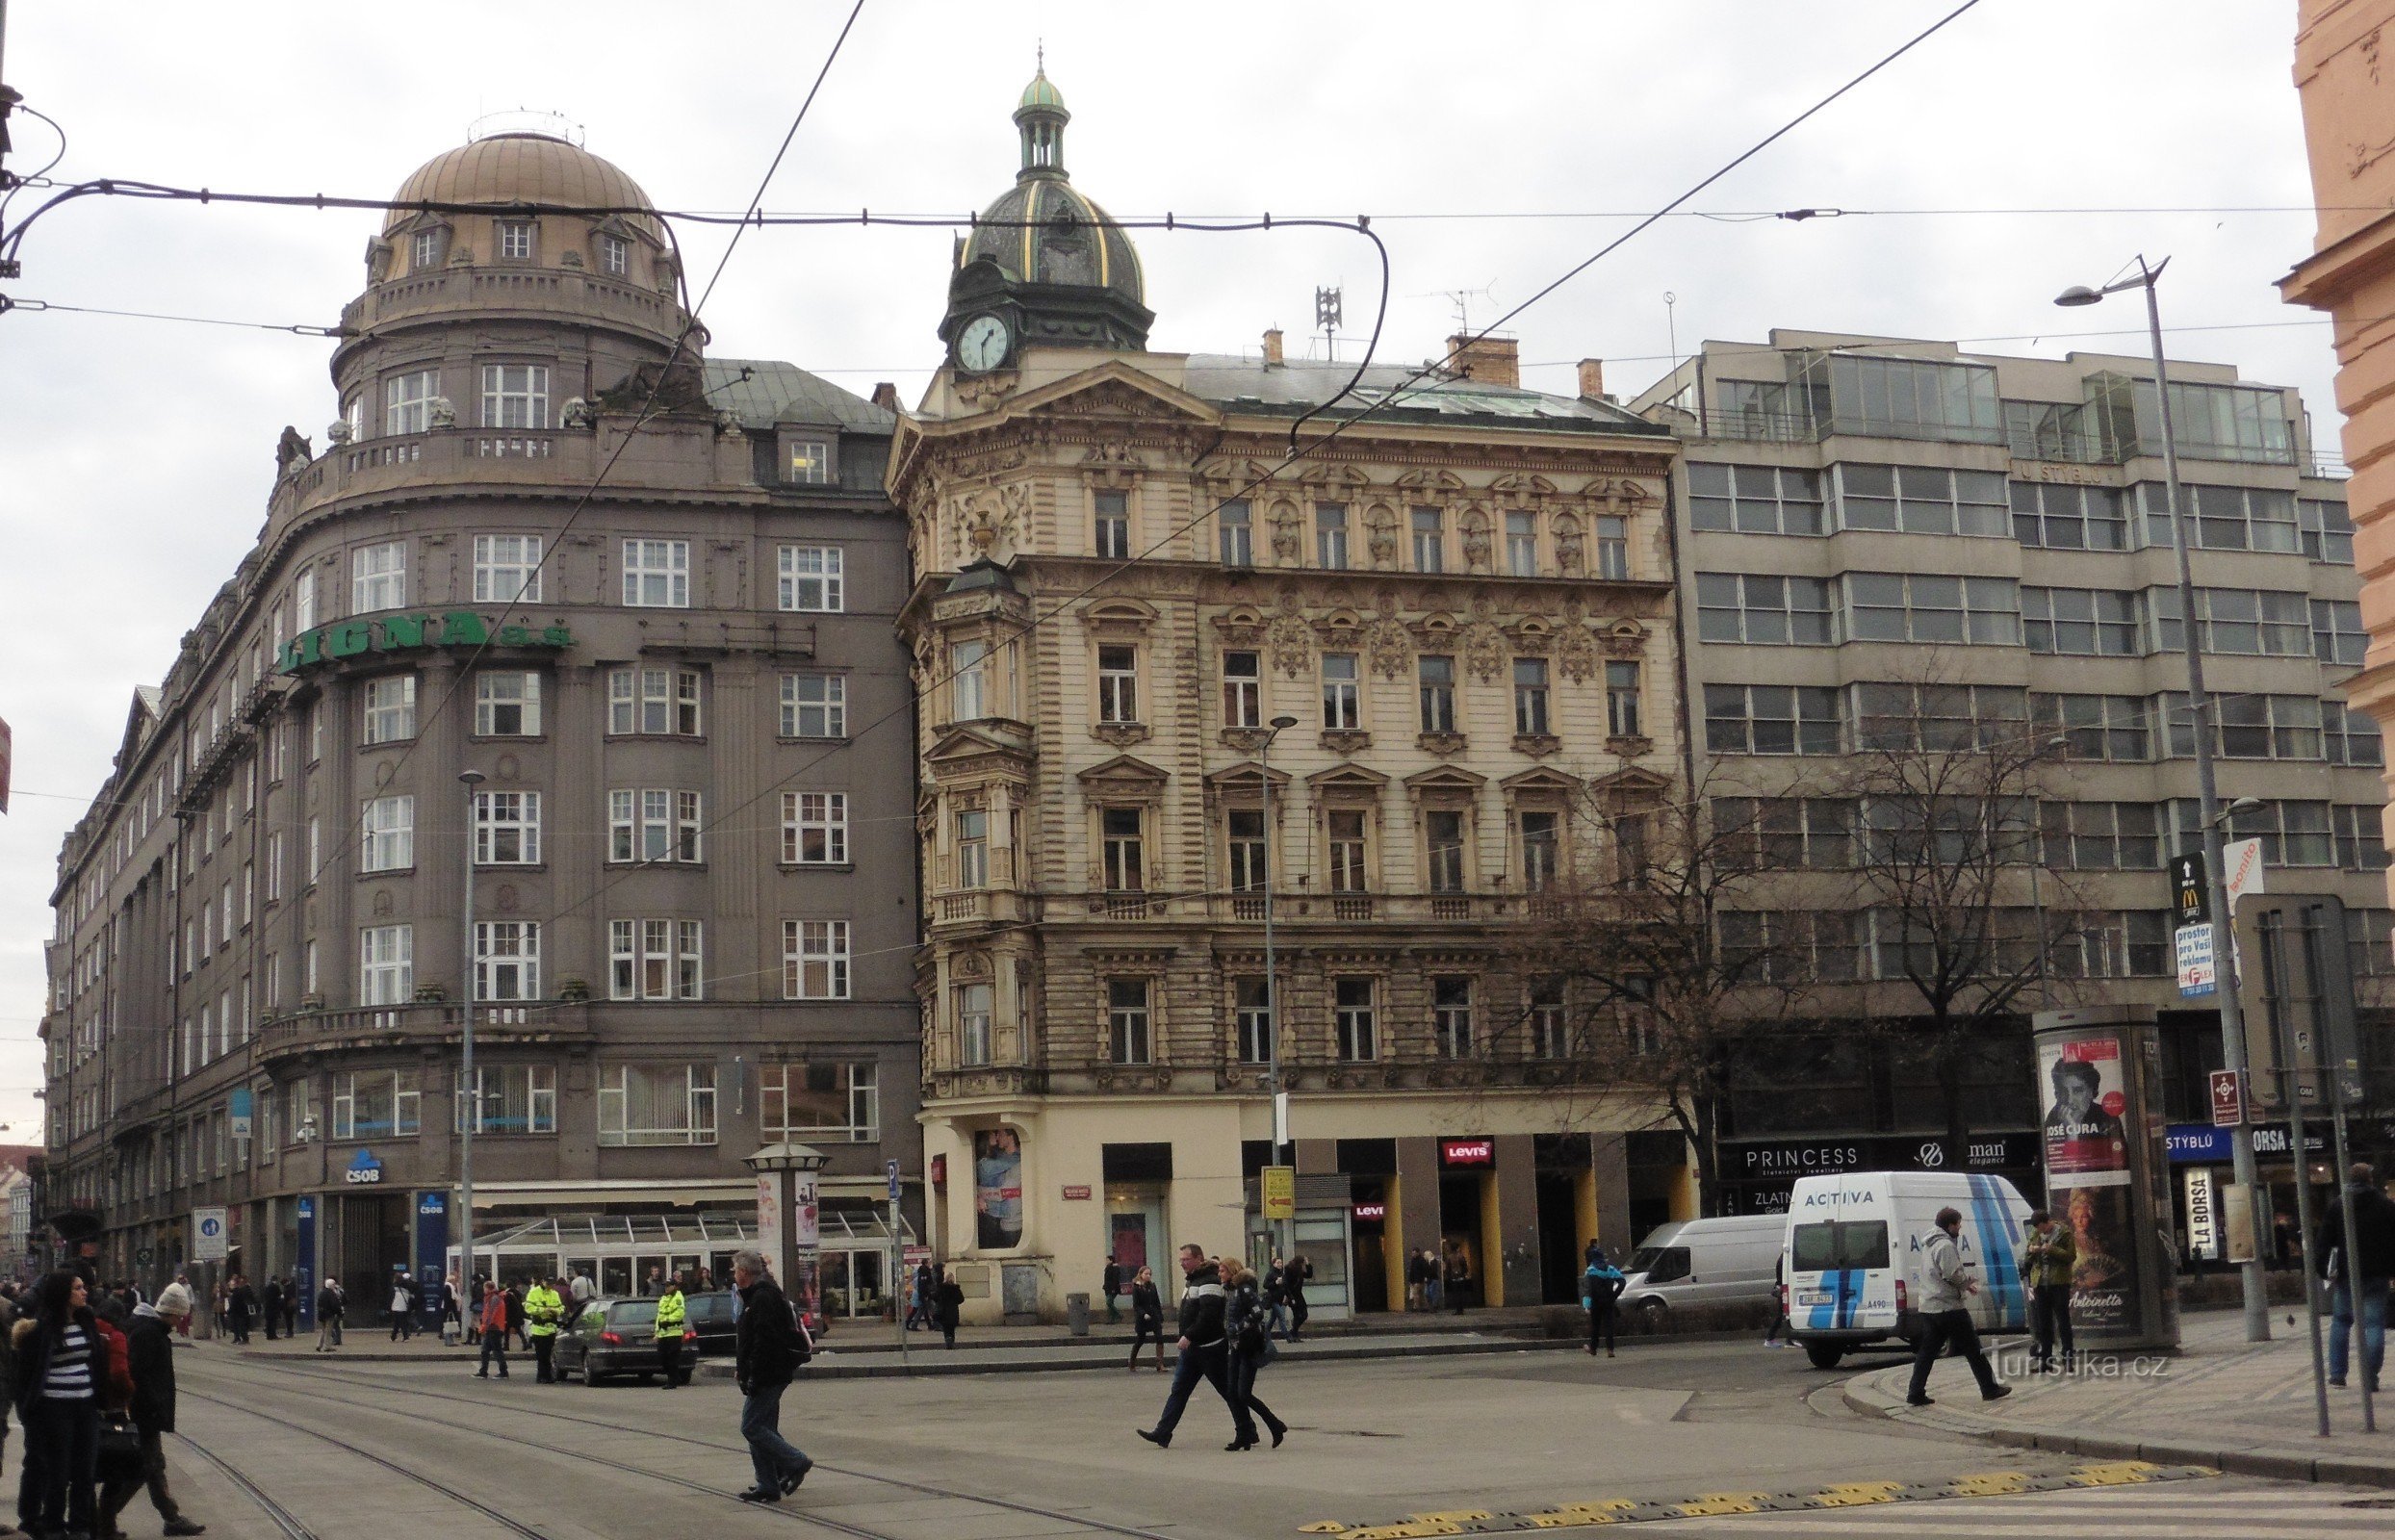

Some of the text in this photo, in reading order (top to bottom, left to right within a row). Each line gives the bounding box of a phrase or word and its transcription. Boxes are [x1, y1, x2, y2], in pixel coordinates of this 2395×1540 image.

[277, 612, 487, 675] LIGNA
[2228, 842, 2256, 894] bonito
[2177, 927, 2210, 944] prostor
[2178, 937, 2211, 958] pro Vaši
[2179, 954, 2212, 968] reklamu
[2047, 1122, 2099, 1137] JOSÉ CURA
[1746, 1148, 1857, 1168] PRINCESS
[1968, 1143, 2006, 1158] man
[1970, 1156, 2005, 1166] elegance
[346, 1168, 379, 1183] ČSOB
[888, 1165, 895, 1188] P
[1804, 1191, 1873, 1207] ACTIVA
[1765, 1205, 1784, 1215] Gold
[2191, 1179, 2211, 1245] LA BORSA
[1867, 1300, 1887, 1309] A490
